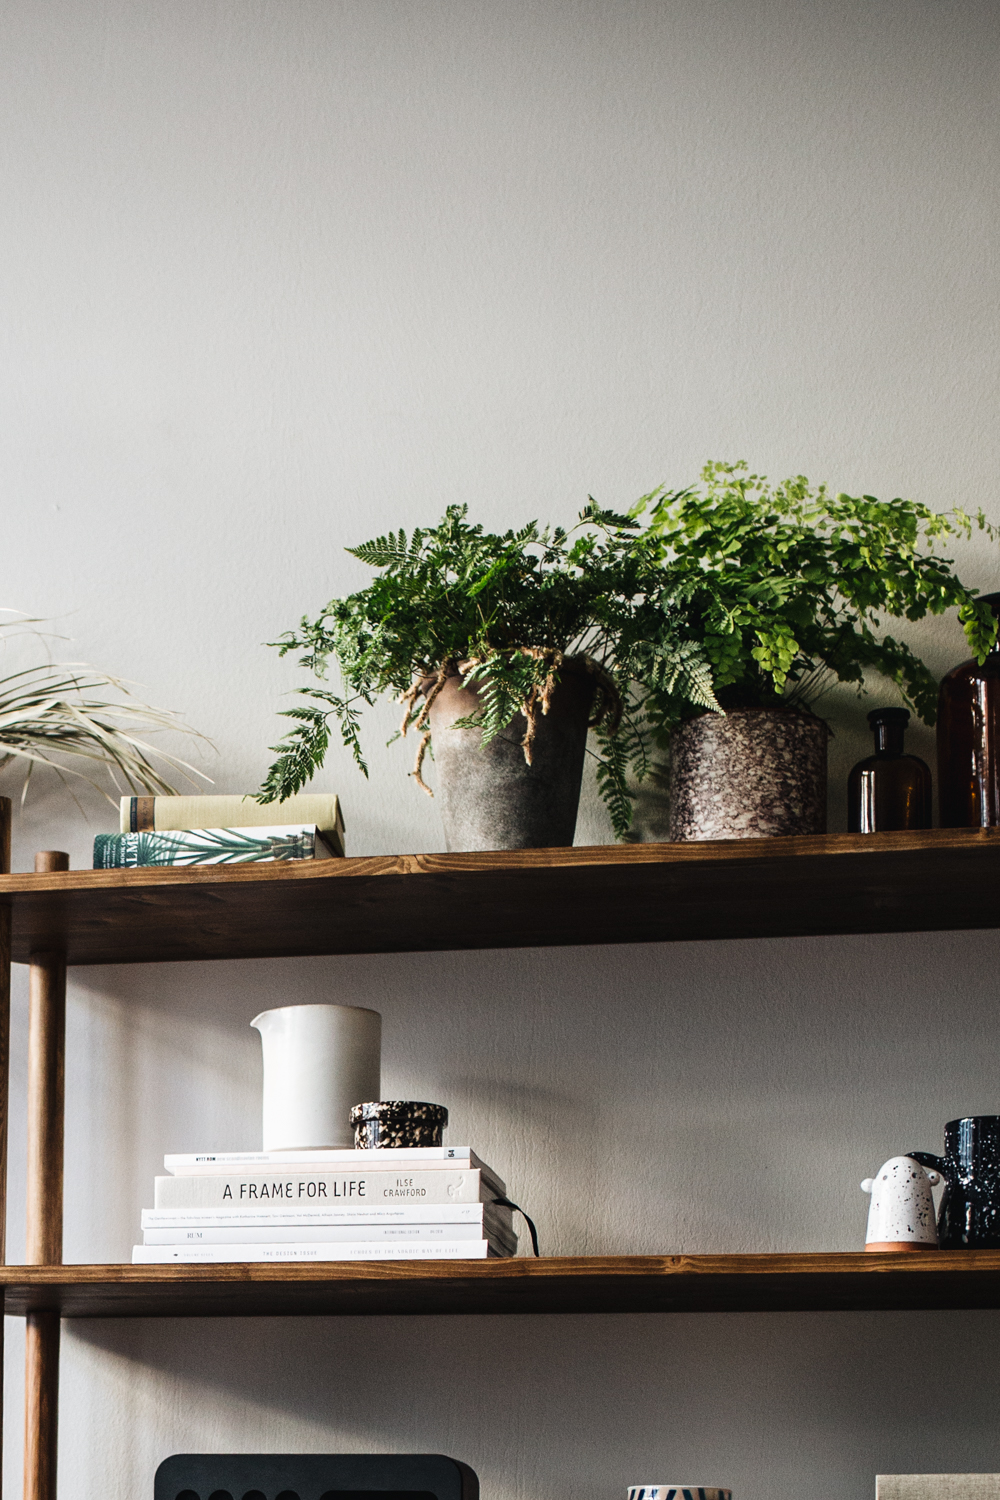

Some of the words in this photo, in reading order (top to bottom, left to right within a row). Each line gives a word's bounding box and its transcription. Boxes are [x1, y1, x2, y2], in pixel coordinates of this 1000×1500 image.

[126, 832, 139, 869] ALMS
[396, 1178, 413, 1187] ILSE
[222, 1184, 233, 1200] A
[240, 1182, 293, 1199] FRAME
[298, 1181, 328, 1198] FOR
[333, 1180, 366, 1197] LIFE
[383, 1188, 427, 1197] CRAWFORD
